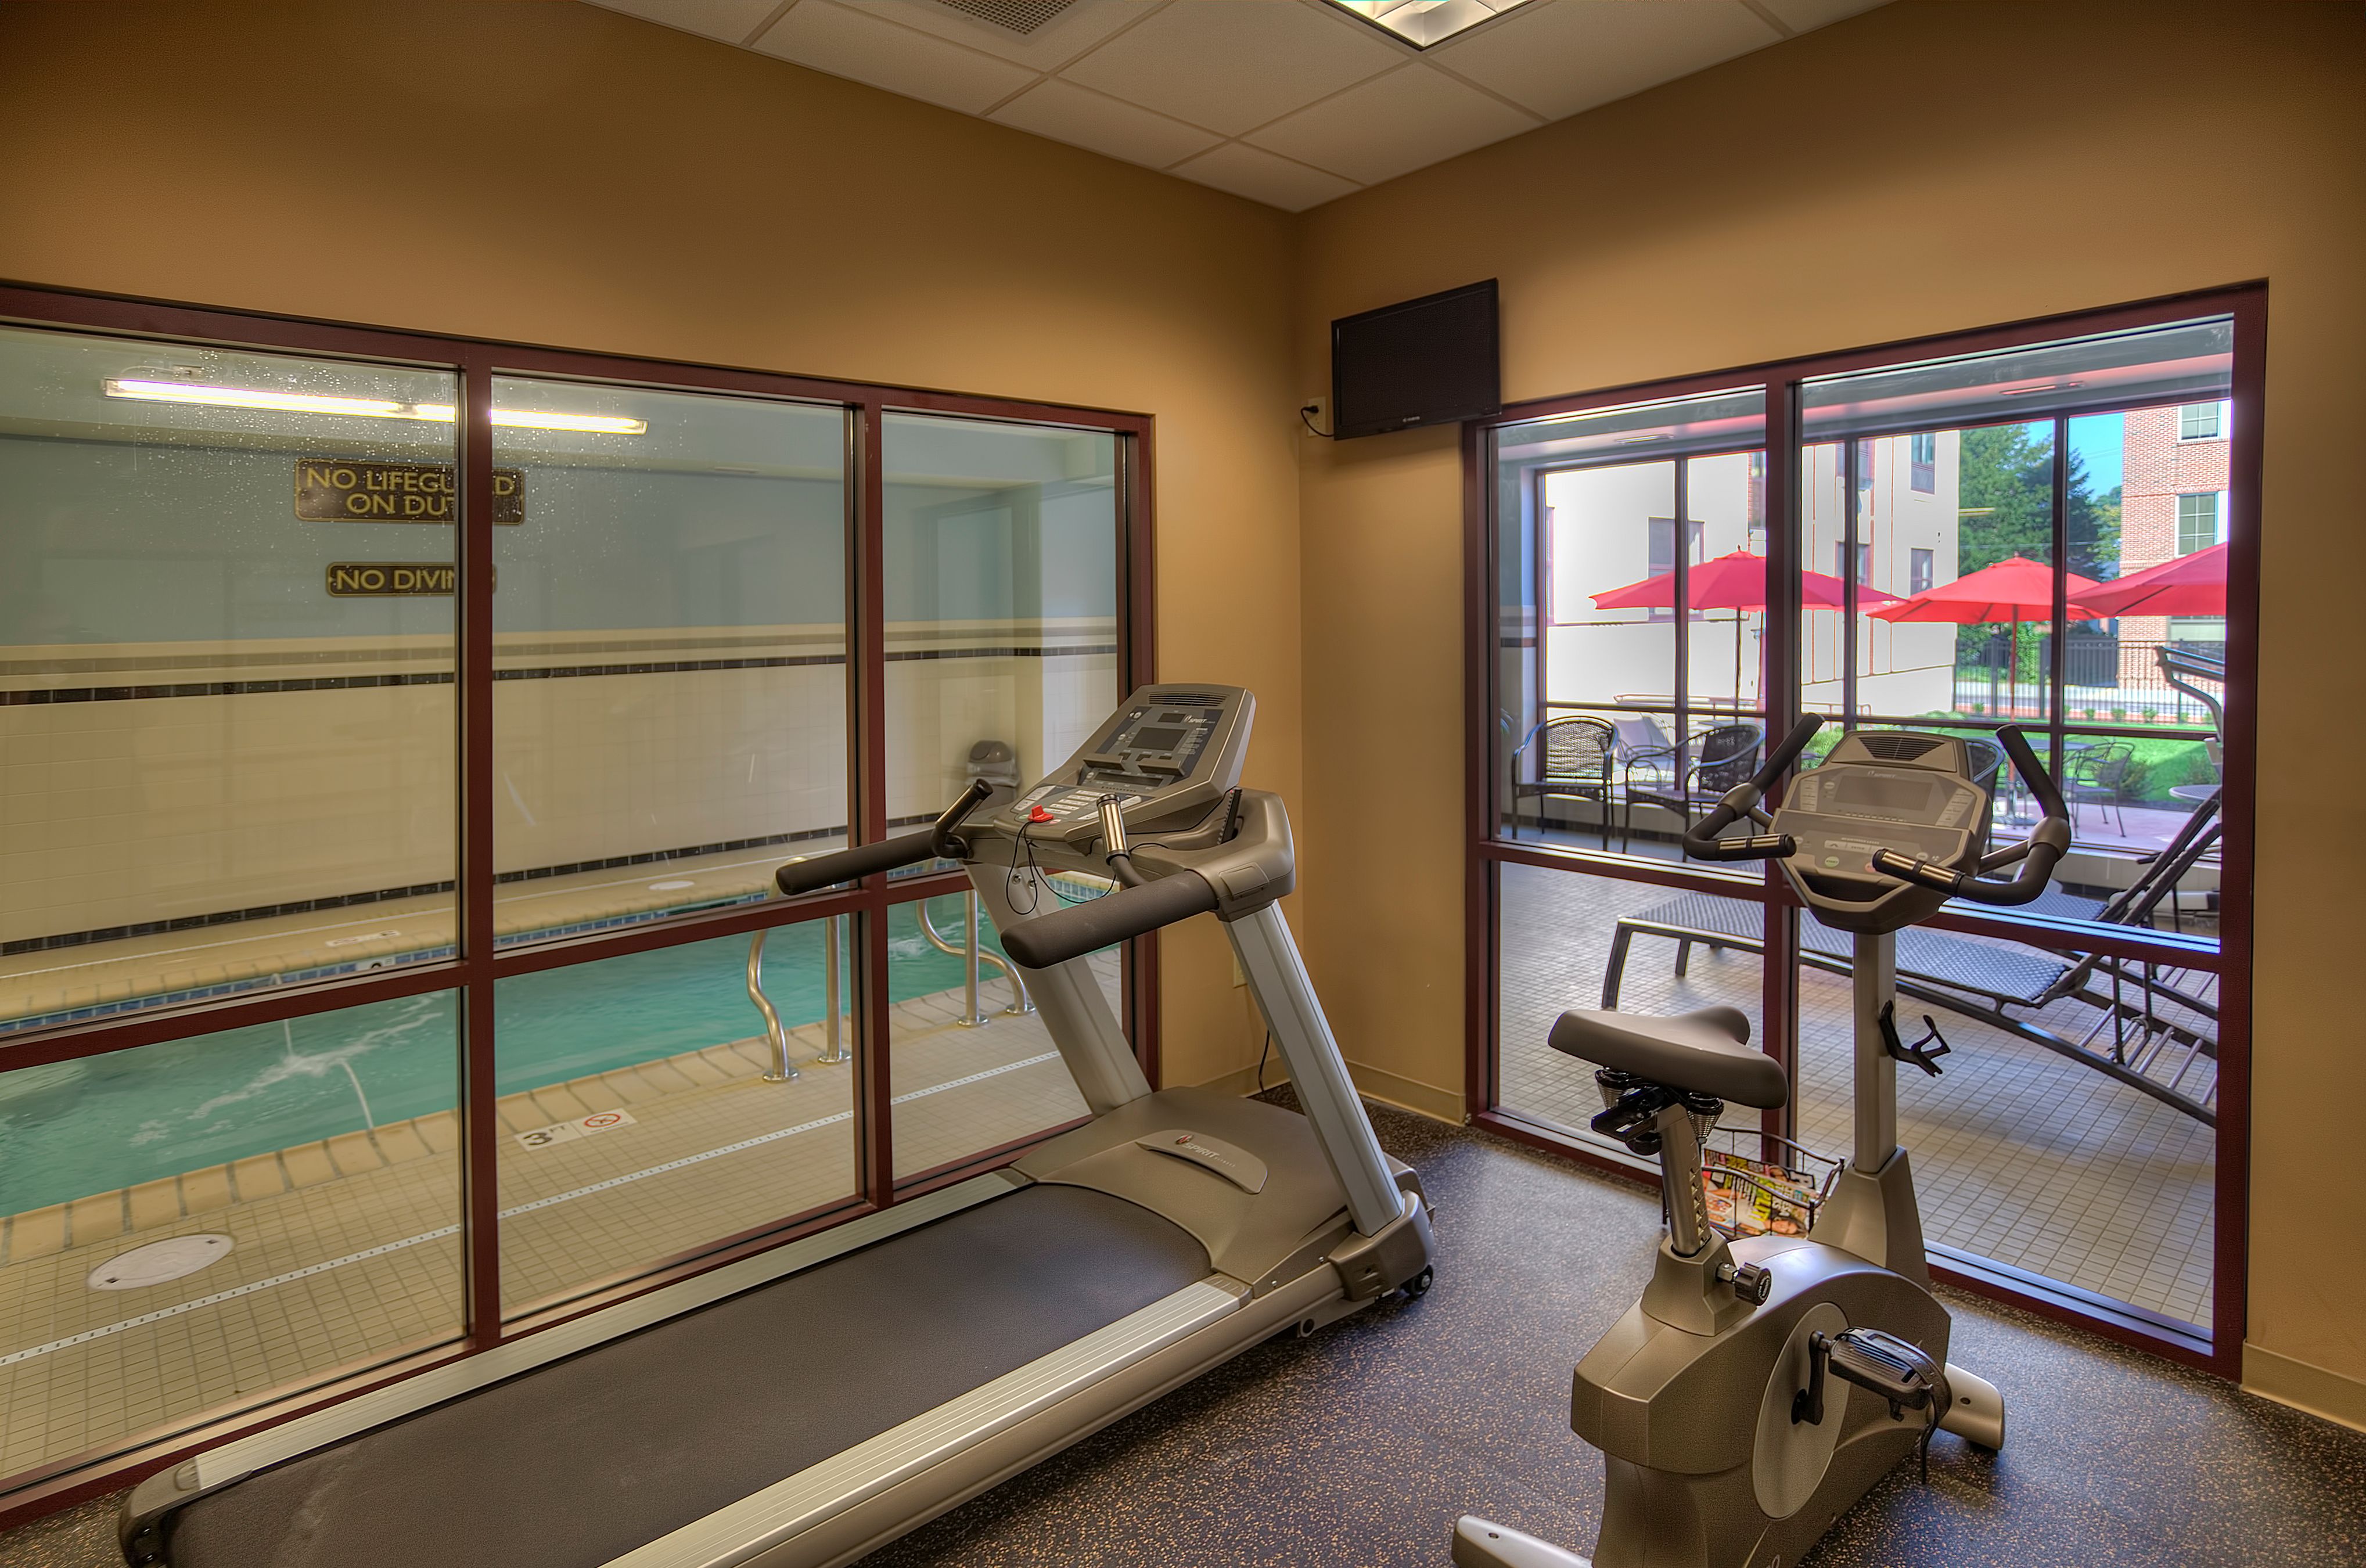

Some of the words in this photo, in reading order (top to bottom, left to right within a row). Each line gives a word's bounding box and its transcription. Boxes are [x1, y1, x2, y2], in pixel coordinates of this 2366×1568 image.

[307, 467, 357, 490] NO
[366, 470, 515, 496] LIFEGUD
[346, 493, 395, 514] ON
[336, 569, 386, 591] NO
[523, 1132, 552, 1146] 3
[1182, 1142, 1220, 1158] SPIRIT
